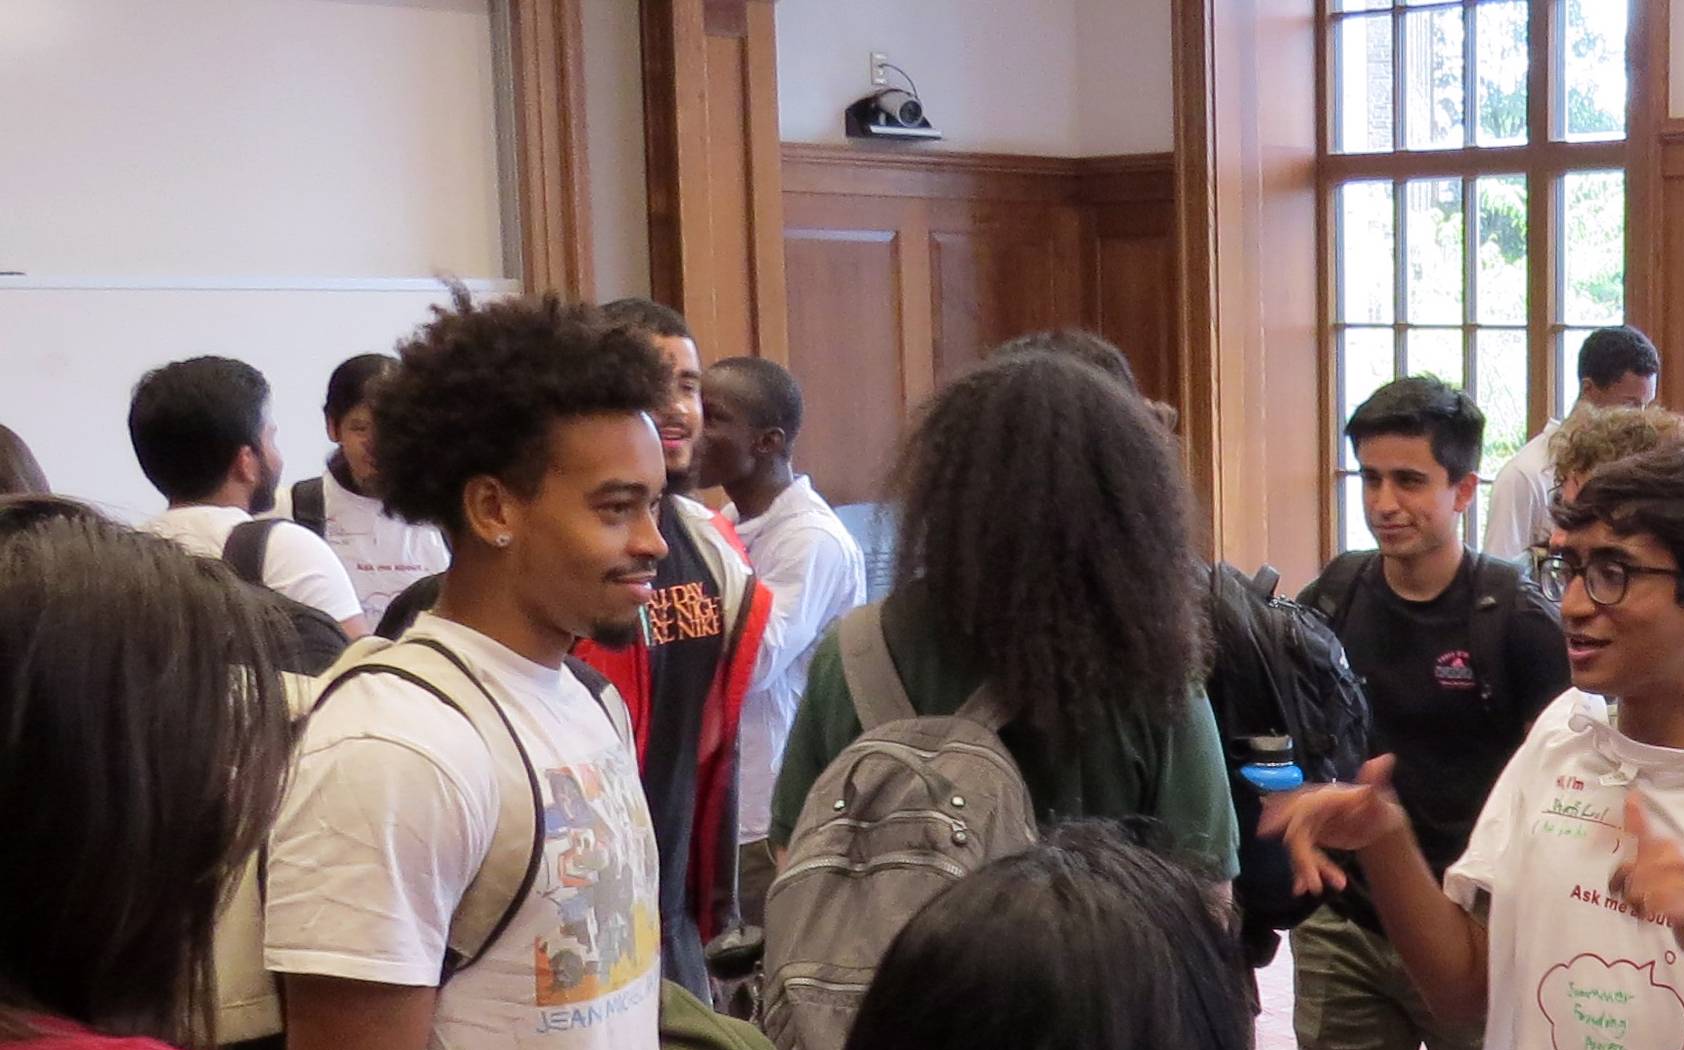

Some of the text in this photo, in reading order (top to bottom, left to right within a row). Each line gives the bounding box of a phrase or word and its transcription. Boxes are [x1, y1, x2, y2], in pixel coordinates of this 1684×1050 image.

[670, 582, 704, 604] DAY
[1569, 884, 1600, 906] Ask
[1604, 897, 1628, 914] me
[536, 1006, 602, 1034] JEAN
